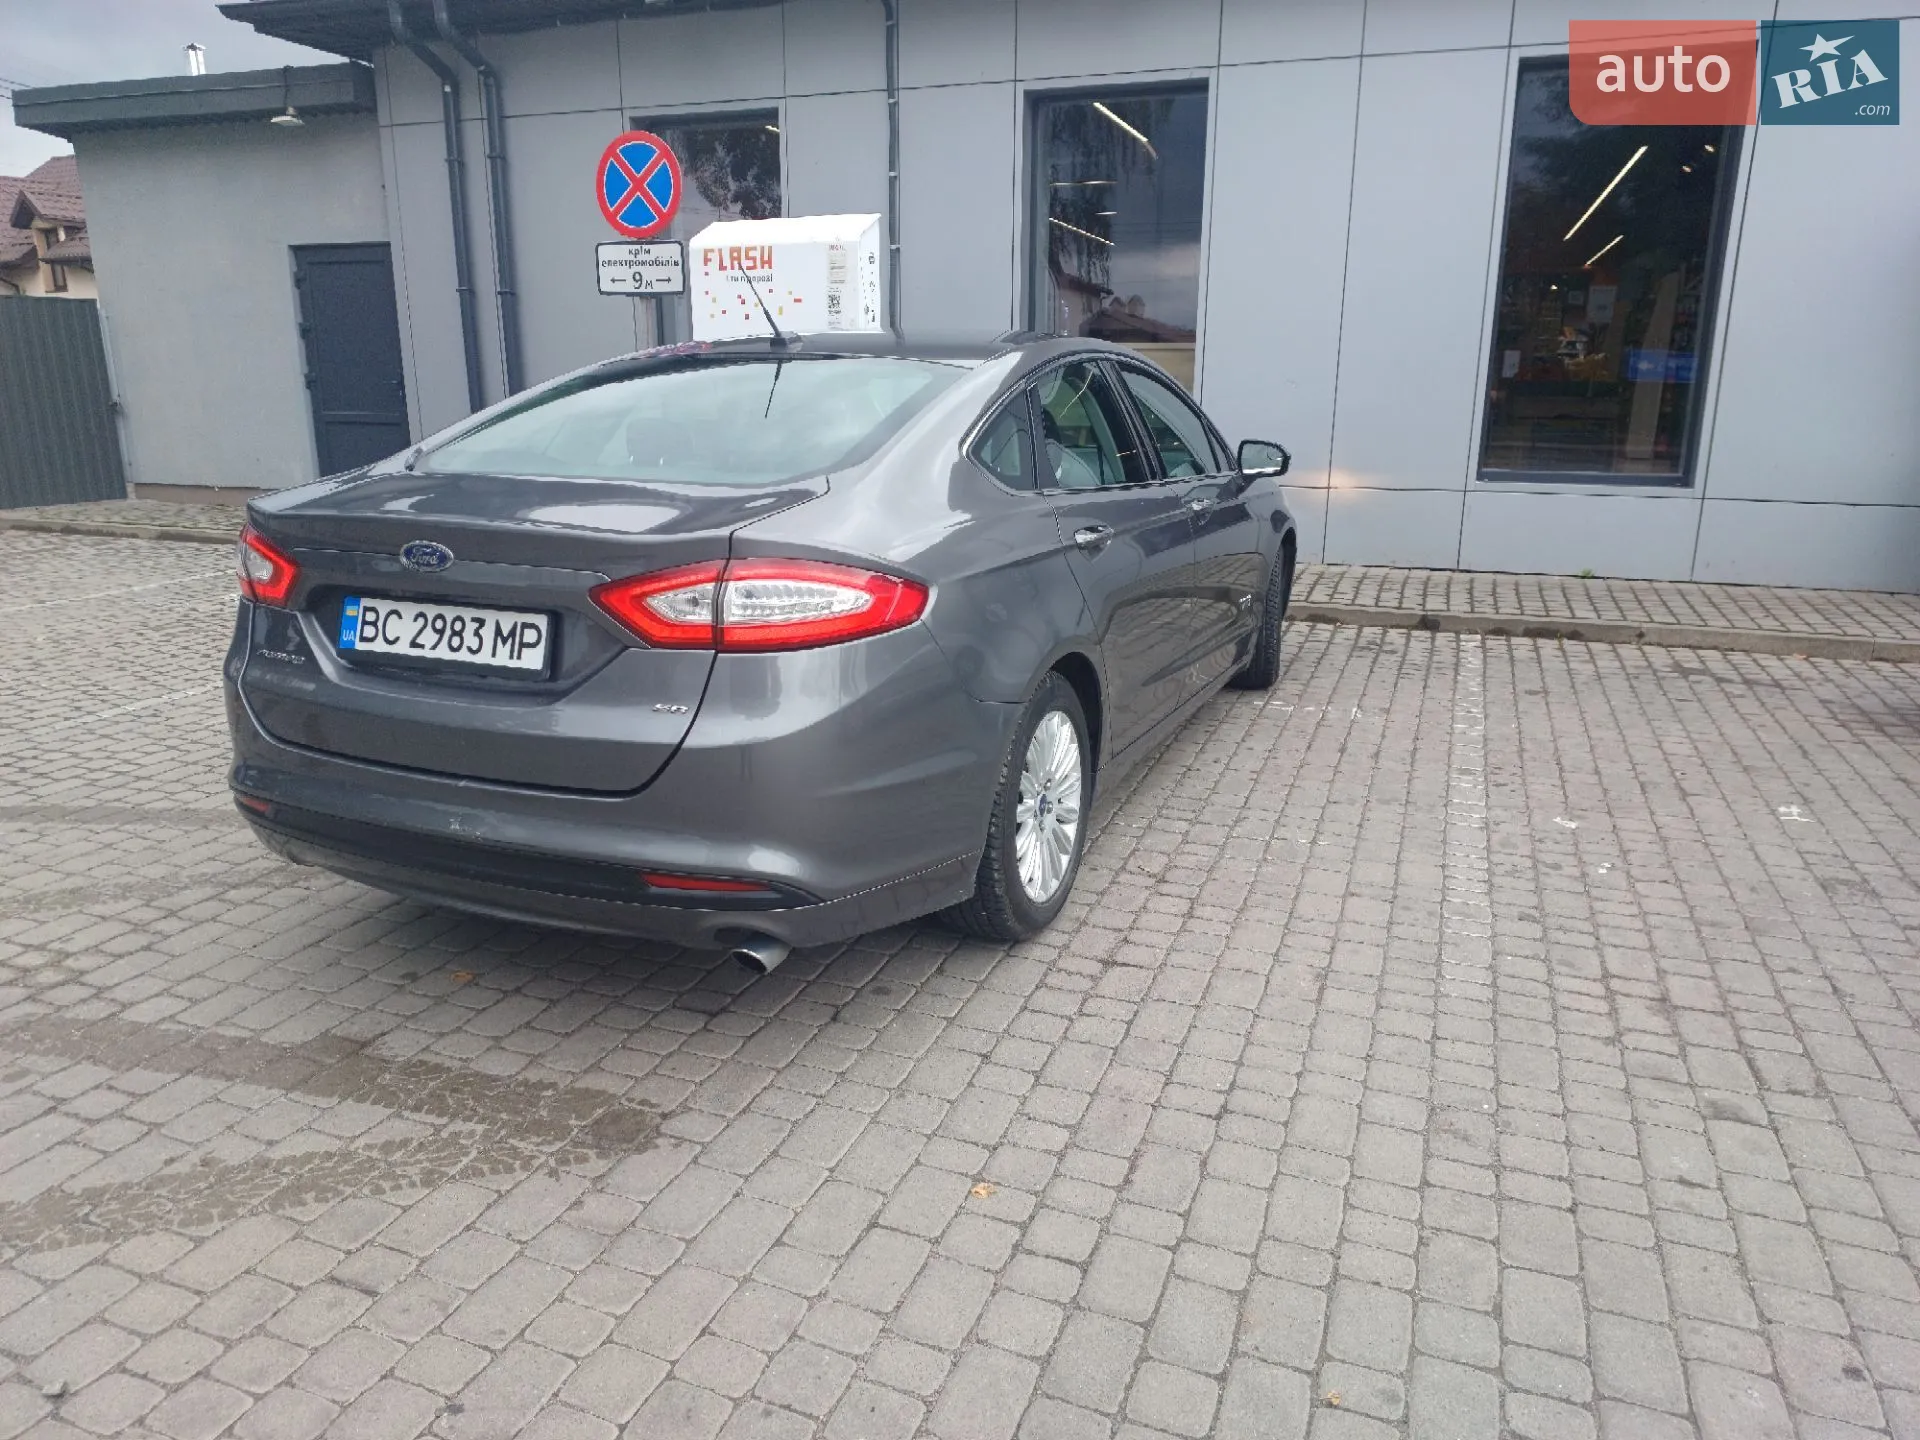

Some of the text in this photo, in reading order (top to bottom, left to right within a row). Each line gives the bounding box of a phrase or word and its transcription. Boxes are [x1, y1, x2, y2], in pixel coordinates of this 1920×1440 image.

[628, 245, 651, 258] крім
[703, 246, 773, 271] FLASH
[601, 255, 680, 269] електромобілів
[410, 546, 440, 565] Ford
[342, 630, 355, 641] UA
[358, 605, 543, 660] BC 2983 MP
